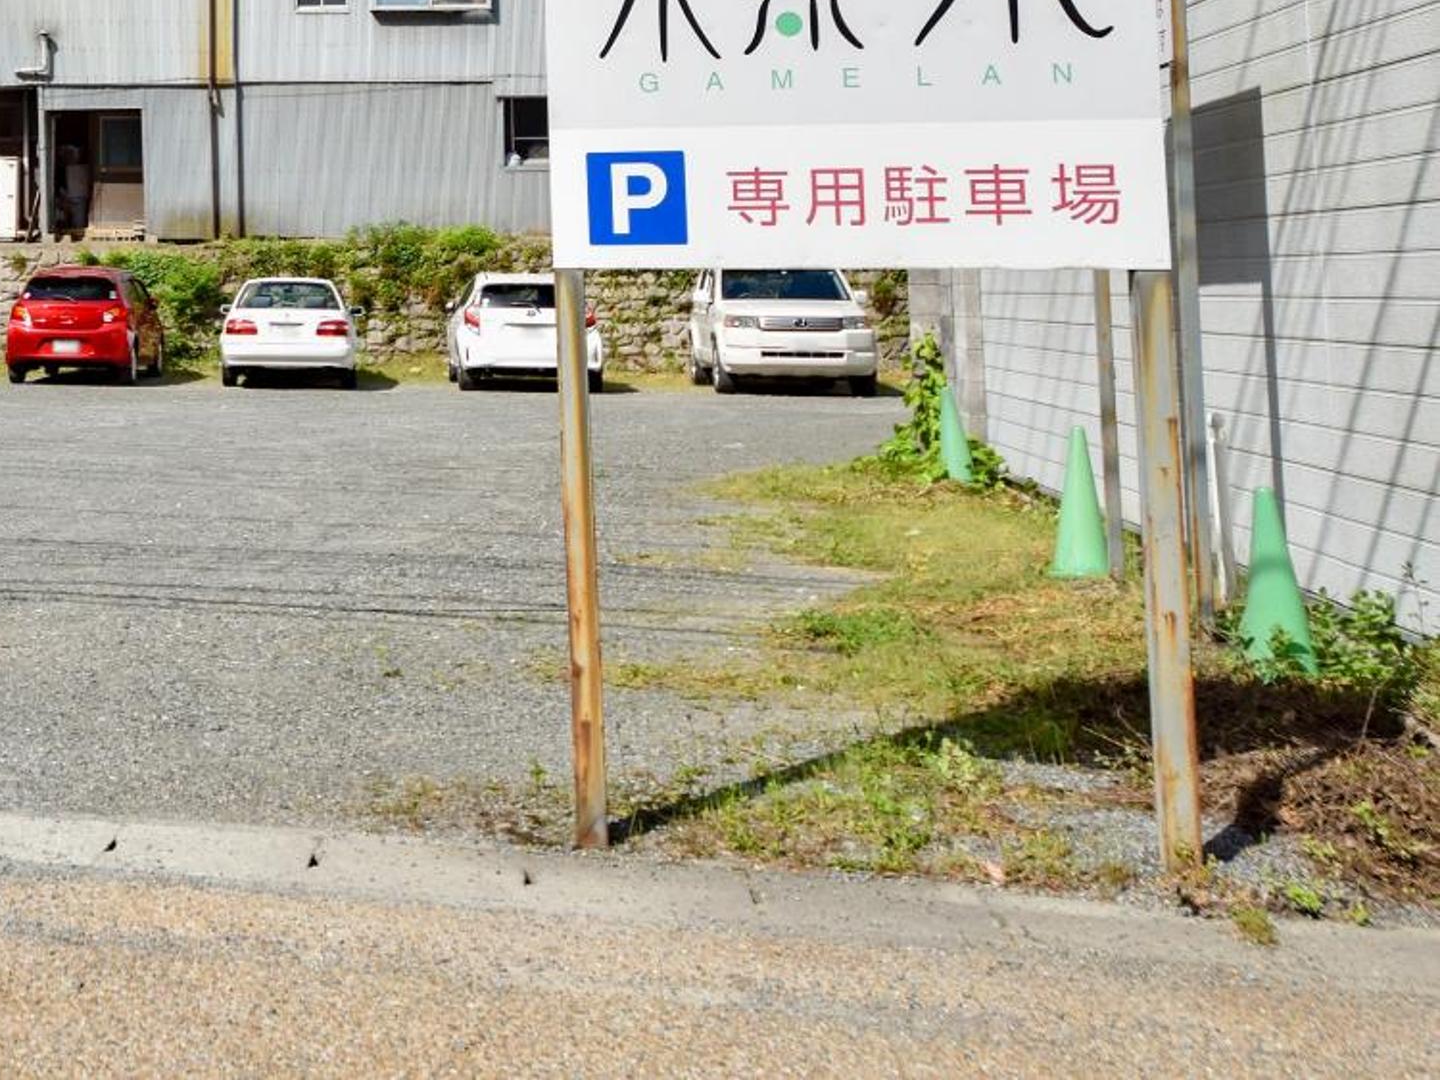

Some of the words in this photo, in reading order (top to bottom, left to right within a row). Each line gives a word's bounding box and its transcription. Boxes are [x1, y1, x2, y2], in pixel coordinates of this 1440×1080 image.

[638, 62, 1074, 94] GAMELAN
[610, 162, 667, 235] P
[726, 163, 1121, 228] 専用駐車場
